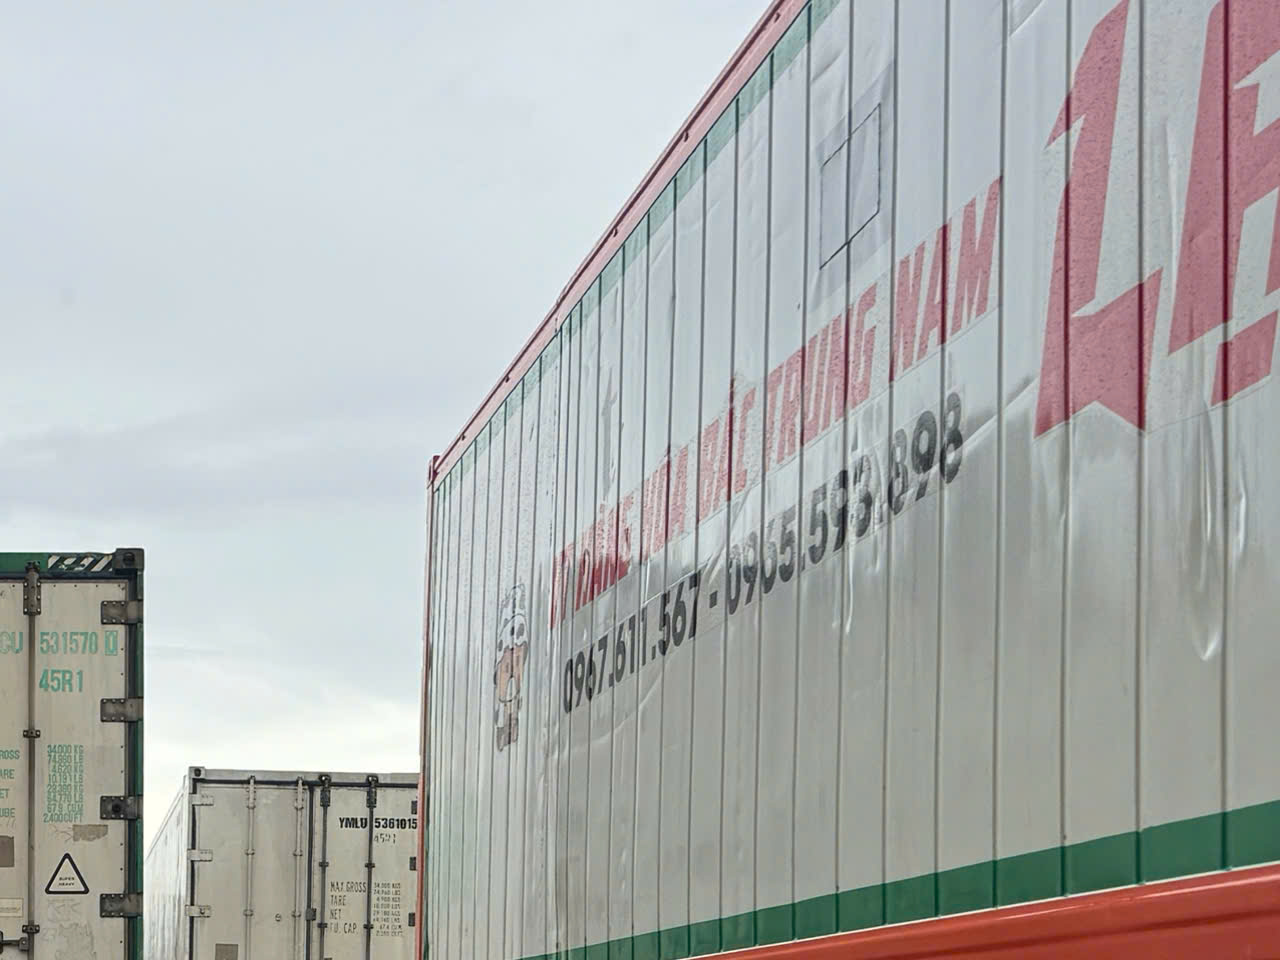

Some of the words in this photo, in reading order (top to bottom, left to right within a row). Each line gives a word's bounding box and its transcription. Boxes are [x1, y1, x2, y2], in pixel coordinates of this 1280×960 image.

[889, 175, 1003, 384] NAM
[39, 669, 83, 693] 45R1
[564, 570, 702, 714] 0967.611.567
[338, 817, 368, 829] YMLU
[374, 817, 418, 829] 5361015
